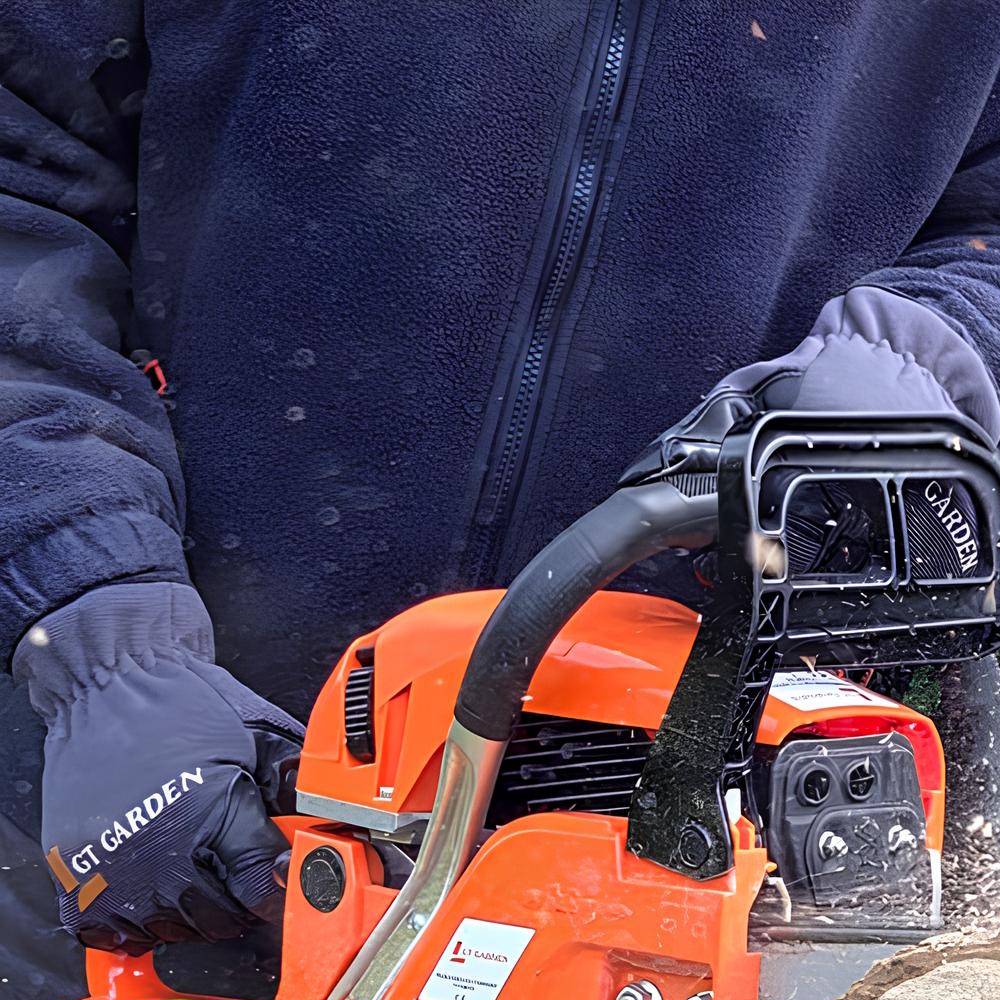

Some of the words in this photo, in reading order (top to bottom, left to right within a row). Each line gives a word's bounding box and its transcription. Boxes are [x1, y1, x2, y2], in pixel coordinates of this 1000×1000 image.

[925, 481, 978, 572] GARDEN
[72, 844, 101, 874] GT
[101, 767, 204, 852] GARDEN
